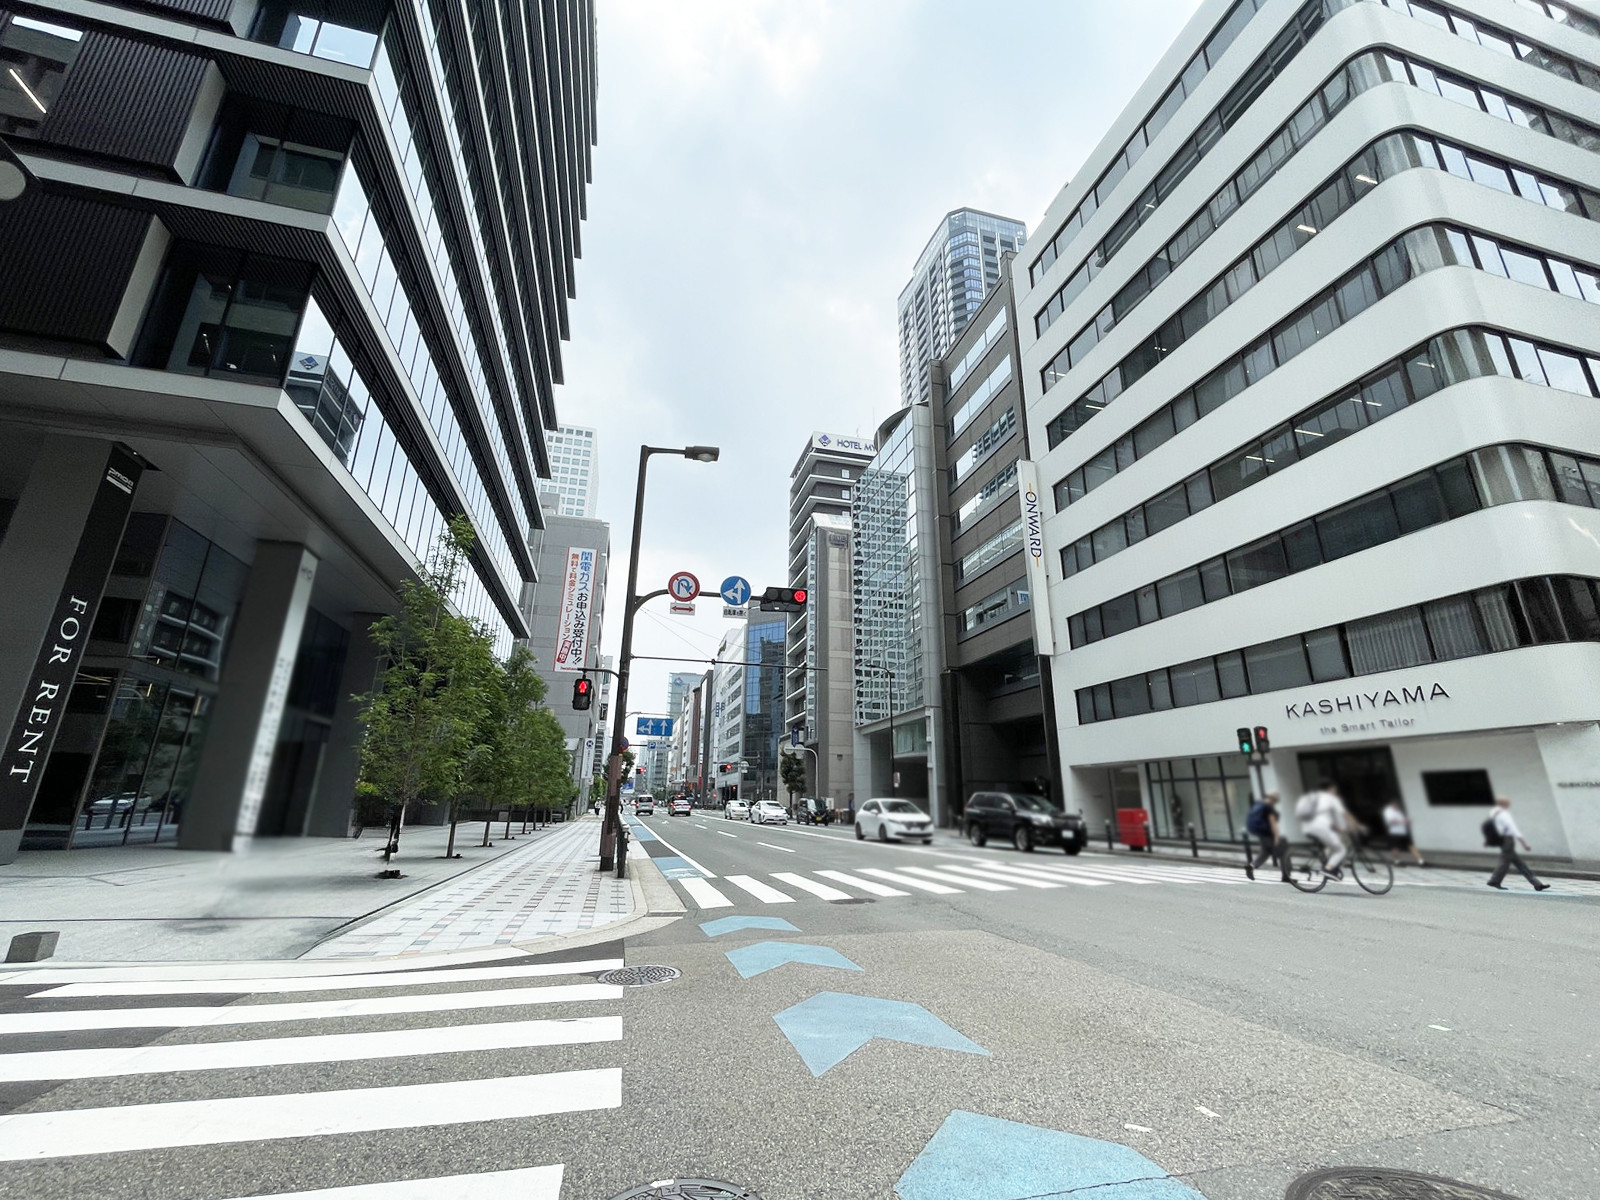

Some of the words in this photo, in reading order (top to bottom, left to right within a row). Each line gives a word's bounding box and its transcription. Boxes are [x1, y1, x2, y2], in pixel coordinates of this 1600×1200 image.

[837, 439, 862, 450] HOTEL
[1025, 491, 1042, 558] ONWARD
[48, 595, 89, 665] FOR
[562, 553, 579, 640] 無料で料金シミュレーション
[9, 680, 60, 783] RENT
[1285, 681, 1451, 720] KASHIYAMA
[1320, 726, 1337, 735] the
[1341, 721, 1376, 733] Smart
[1379, 717, 1415, 728] Tailor
